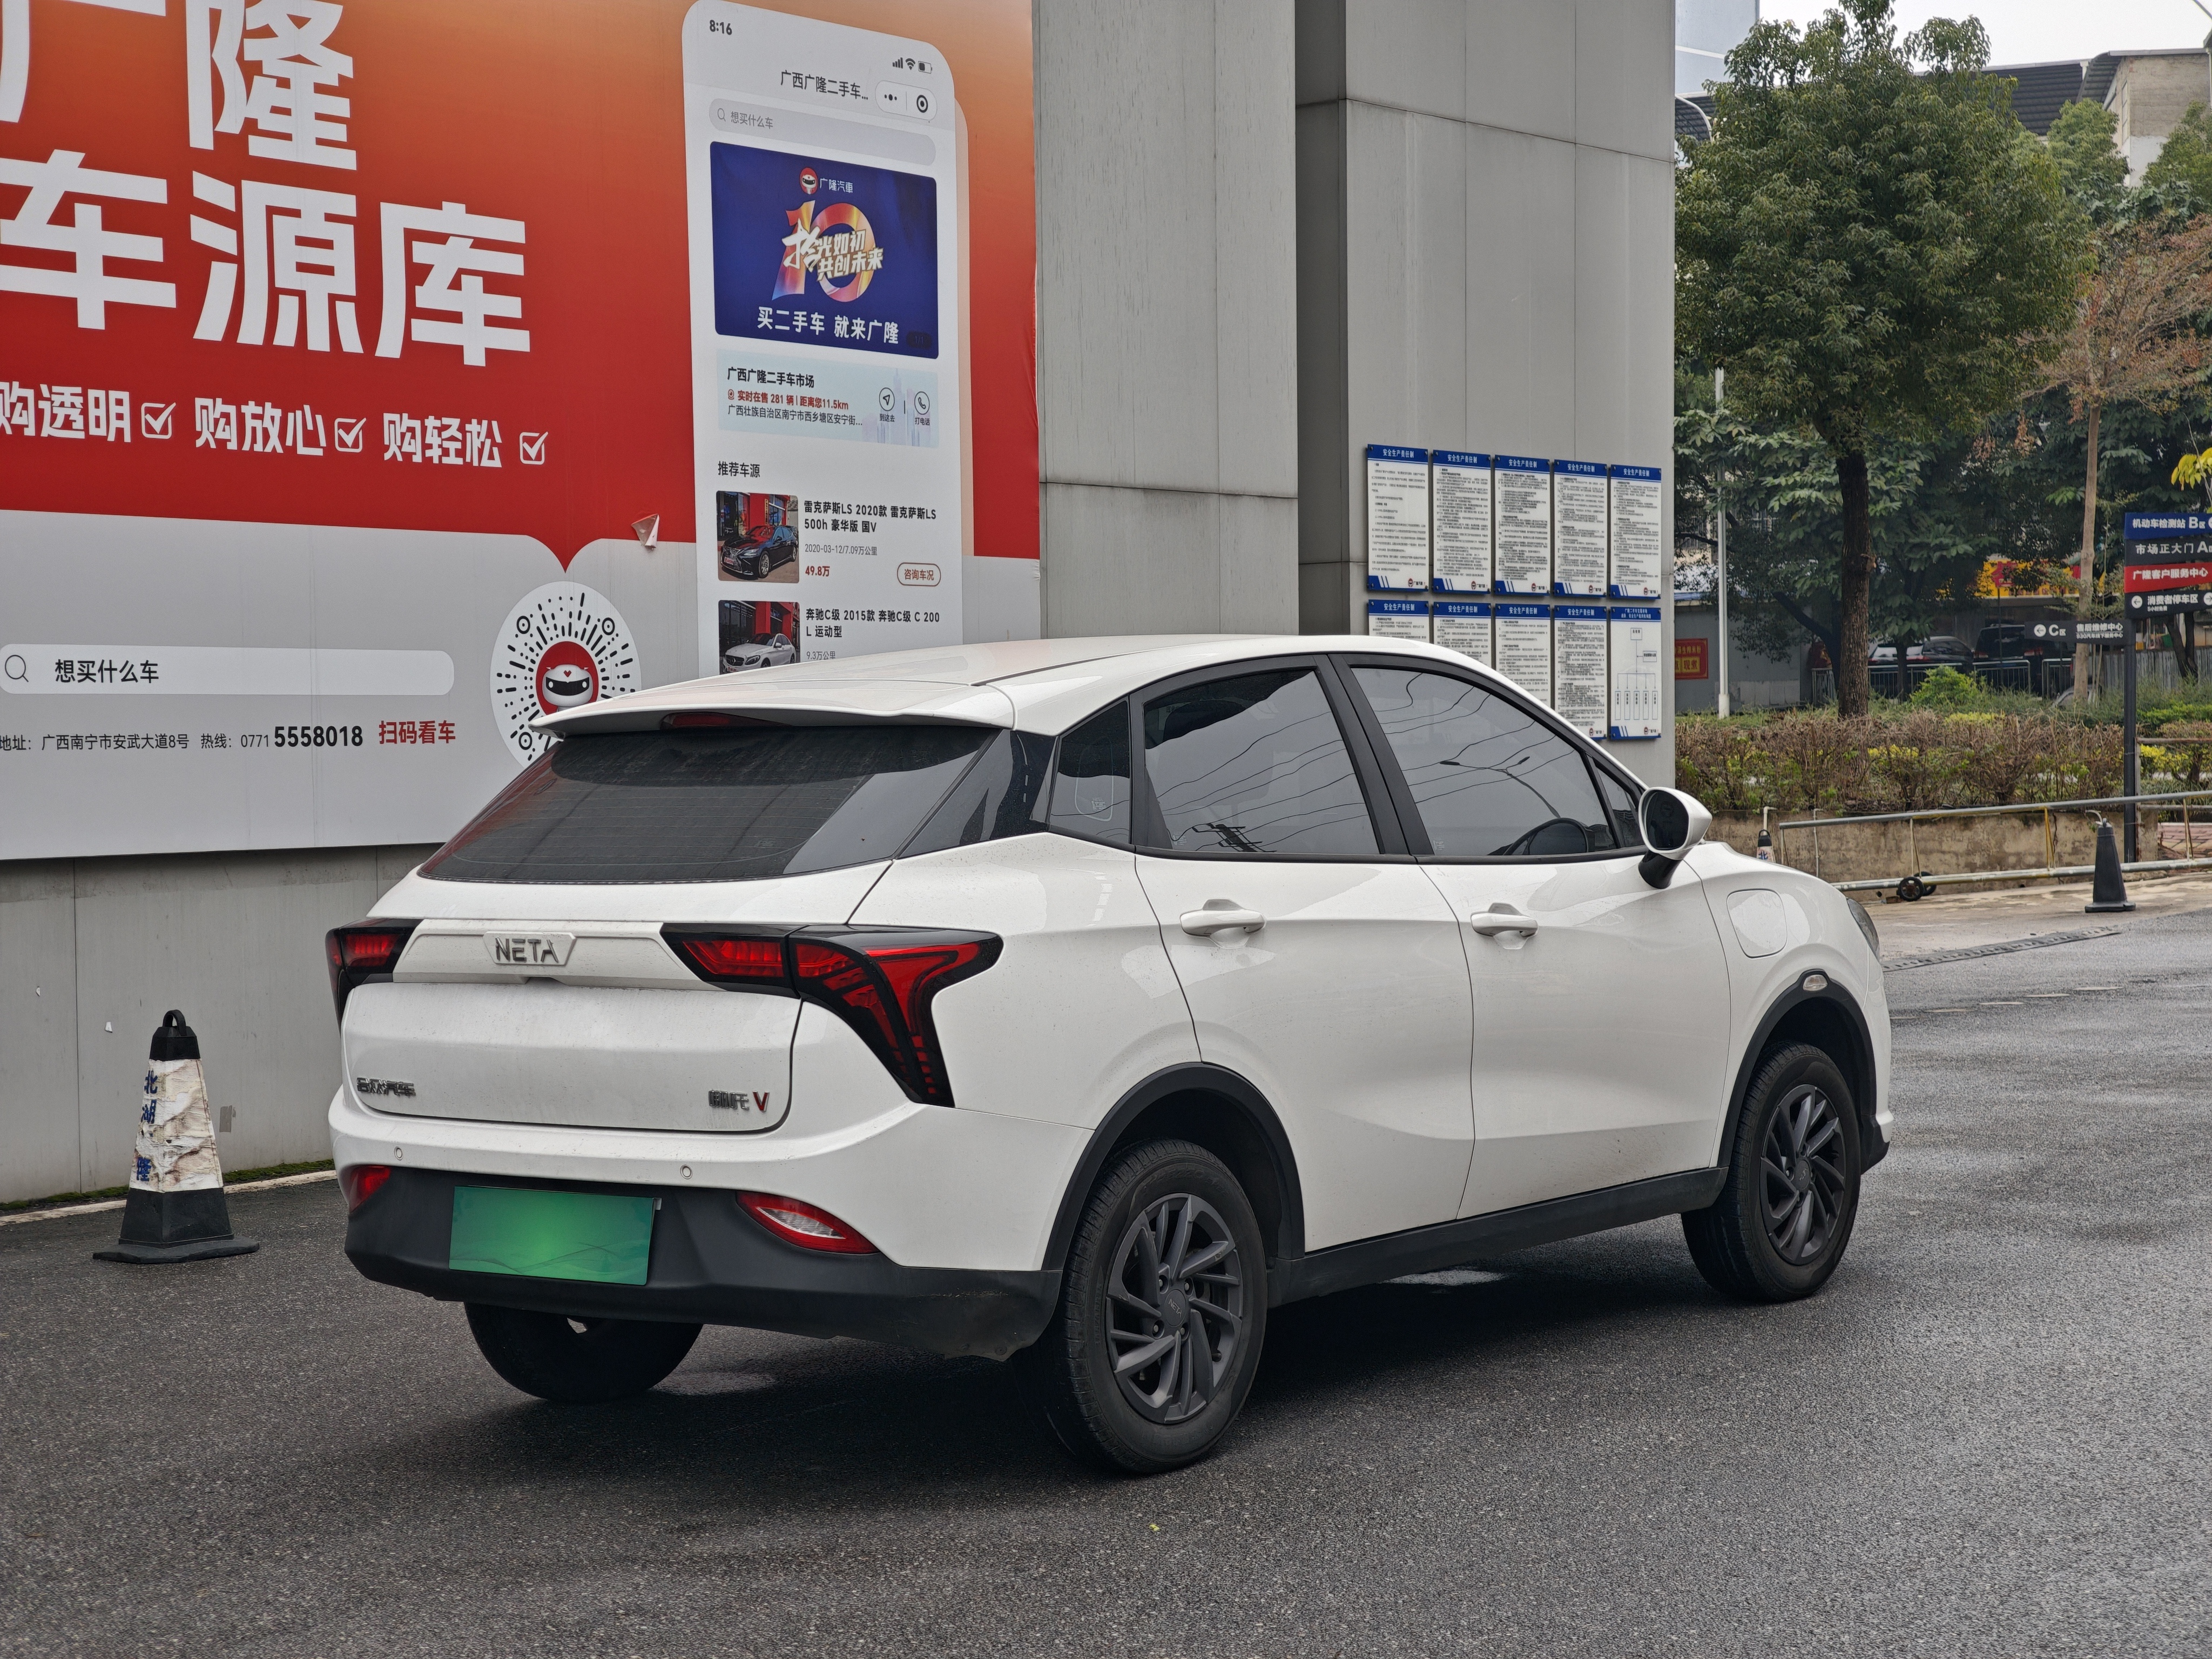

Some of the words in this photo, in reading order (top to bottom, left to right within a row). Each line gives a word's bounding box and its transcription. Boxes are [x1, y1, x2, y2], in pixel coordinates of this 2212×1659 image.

[709, 19, 733, 36] 8:16
[730, 111, 774, 130] 想买什么车
[820, 178, 853, 193] 广隆汽車
[0, 149, 530, 367] 车源库
[817, 247, 884, 281] 共创未来
[757, 306, 825, 335] 买二手车
[834, 315, 899, 344] 就来广隆
[727, 367, 814, 388] 广西广隆二手车市场
[738, 390, 768, 403] 实时在售
[771, 394, 784, 404] 281
[786, 394, 794, 406] 辆
[800, 396, 848, 410] 距离您11.5km
[0, 381, 131, 443] 购透明
[195, 396, 325, 456] 购放心
[383, 413, 502, 468] 购轻松
[879, 414, 895, 422] 到这去
[915, 417, 930, 426] 打电话
[1382, 448, 1414, 458] 安全生产责任制
[1447, 454, 1478, 463] 安全生产责任制
[718, 461, 760, 478] 推荐车源
[1508, 459, 1537, 468] 安全生产责任制
[1567, 463, 1595, 473] 安全生产责任制
[1623, 468, 1650, 477] 安全生产责任制
[804, 500, 852, 514] 雷克萨斯LS
[856, 504, 887, 517] 2020款
[891, 505, 936, 520] 雷克萨斯LS
[805, 518, 827, 530] 500h
[831, 519, 858, 532] 豪华版
[861, 521, 876, 533] 国V
[2133, 518, 2186, 529] 机动车检测站
[805, 544, 878, 556] 2020-03-12/7.09万公里
[2135, 543, 2194, 555] 市场正大门
[805, 565, 830, 577] 49.8万
[904, 568, 934, 581] 咨询车况
[2133, 568, 2208, 580] 广隆客户服务中心
[1384, 603, 1415, 611] 安全生产责任制
[1448, 605, 1478, 613] 安全生产责任制
[806, 608, 840, 621] 奔驰C级
[844, 609, 875, 622] 2015款
[879, 610, 911, 623] 奔驰C级
[914, 612, 920, 622] C
[924, 612, 940, 622] 200
[806, 626, 812, 637] L
[815, 625, 842, 638] 运动型
[806, 651, 836, 660] 9.3万公里
[54, 658, 160, 685] 想买什么车
[41, 733, 190, 751] 广西南宁市安武大道8号
[241, 734, 269, 747] 0771
[274, 725, 363, 747] 5558018
[379, 720, 456, 745] 扫码看车
[495, 937, 559, 963] NETA
[752, 1091, 770, 1112] V
